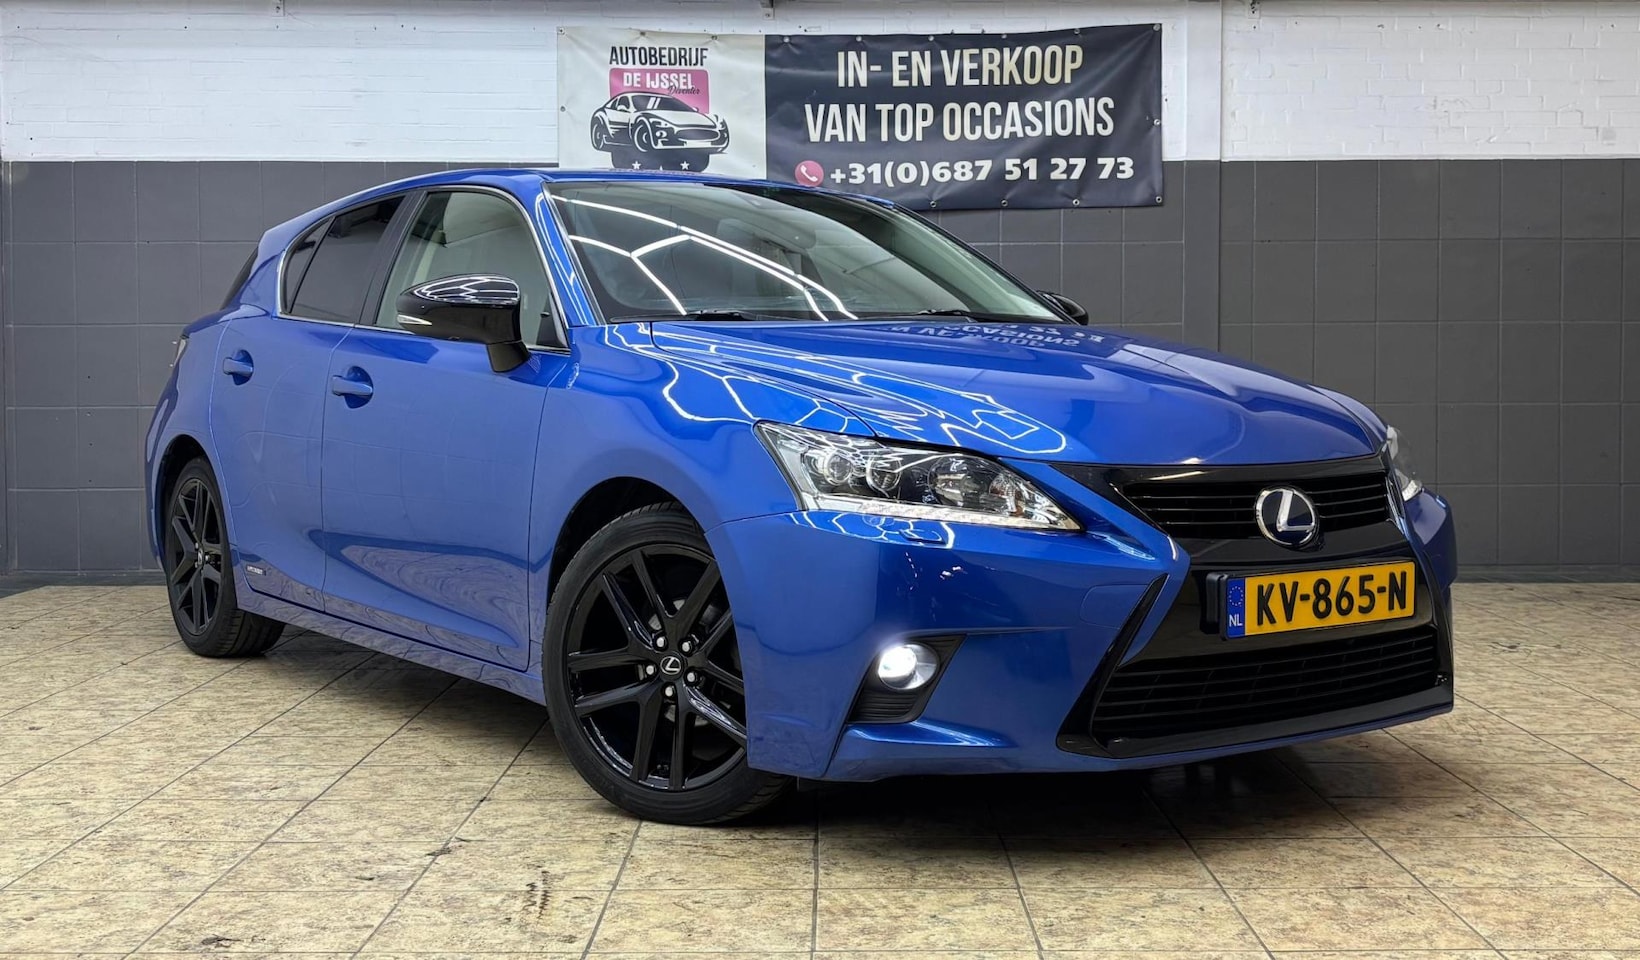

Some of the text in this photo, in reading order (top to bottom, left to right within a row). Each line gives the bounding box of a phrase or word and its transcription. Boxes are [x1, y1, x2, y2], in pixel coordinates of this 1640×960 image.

[609, 46, 708, 67] AUTOBEDRIJF
[837, 44, 1084, 88] IN- EN VERKOOP
[623, 72, 695, 90] DE IJSSEL
[667, 84, 701, 95] Deventer
[804, 97, 1115, 142] VAN TOP OCCASIONS
[830, 157, 1135, 188] +31(0)687 51 27 73
[1257, 571, 1407, 626] KV-865-N
[1228, 614, 1243, 627] NL
